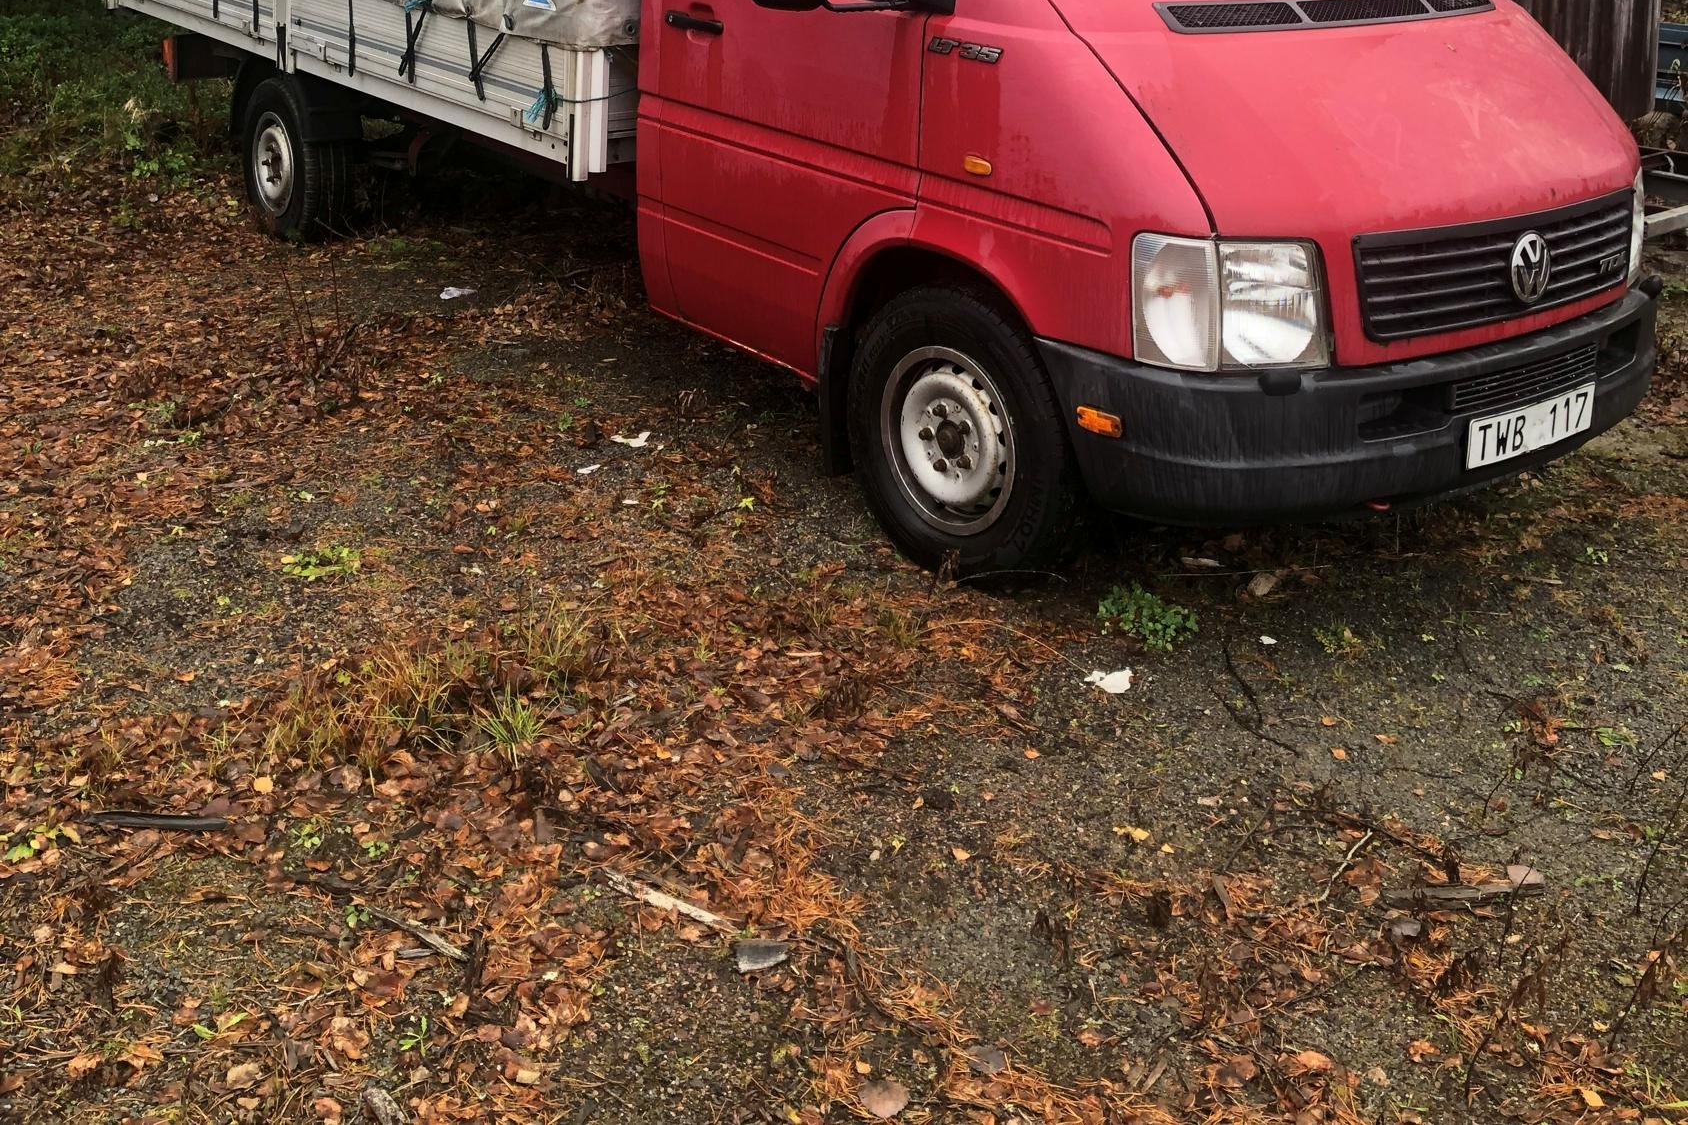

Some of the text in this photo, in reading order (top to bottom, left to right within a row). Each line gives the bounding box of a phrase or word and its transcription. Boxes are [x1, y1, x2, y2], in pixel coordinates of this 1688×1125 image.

[928, 36, 1004, 64] LT 35
[1478, 391, 1589, 461] TWB 117
